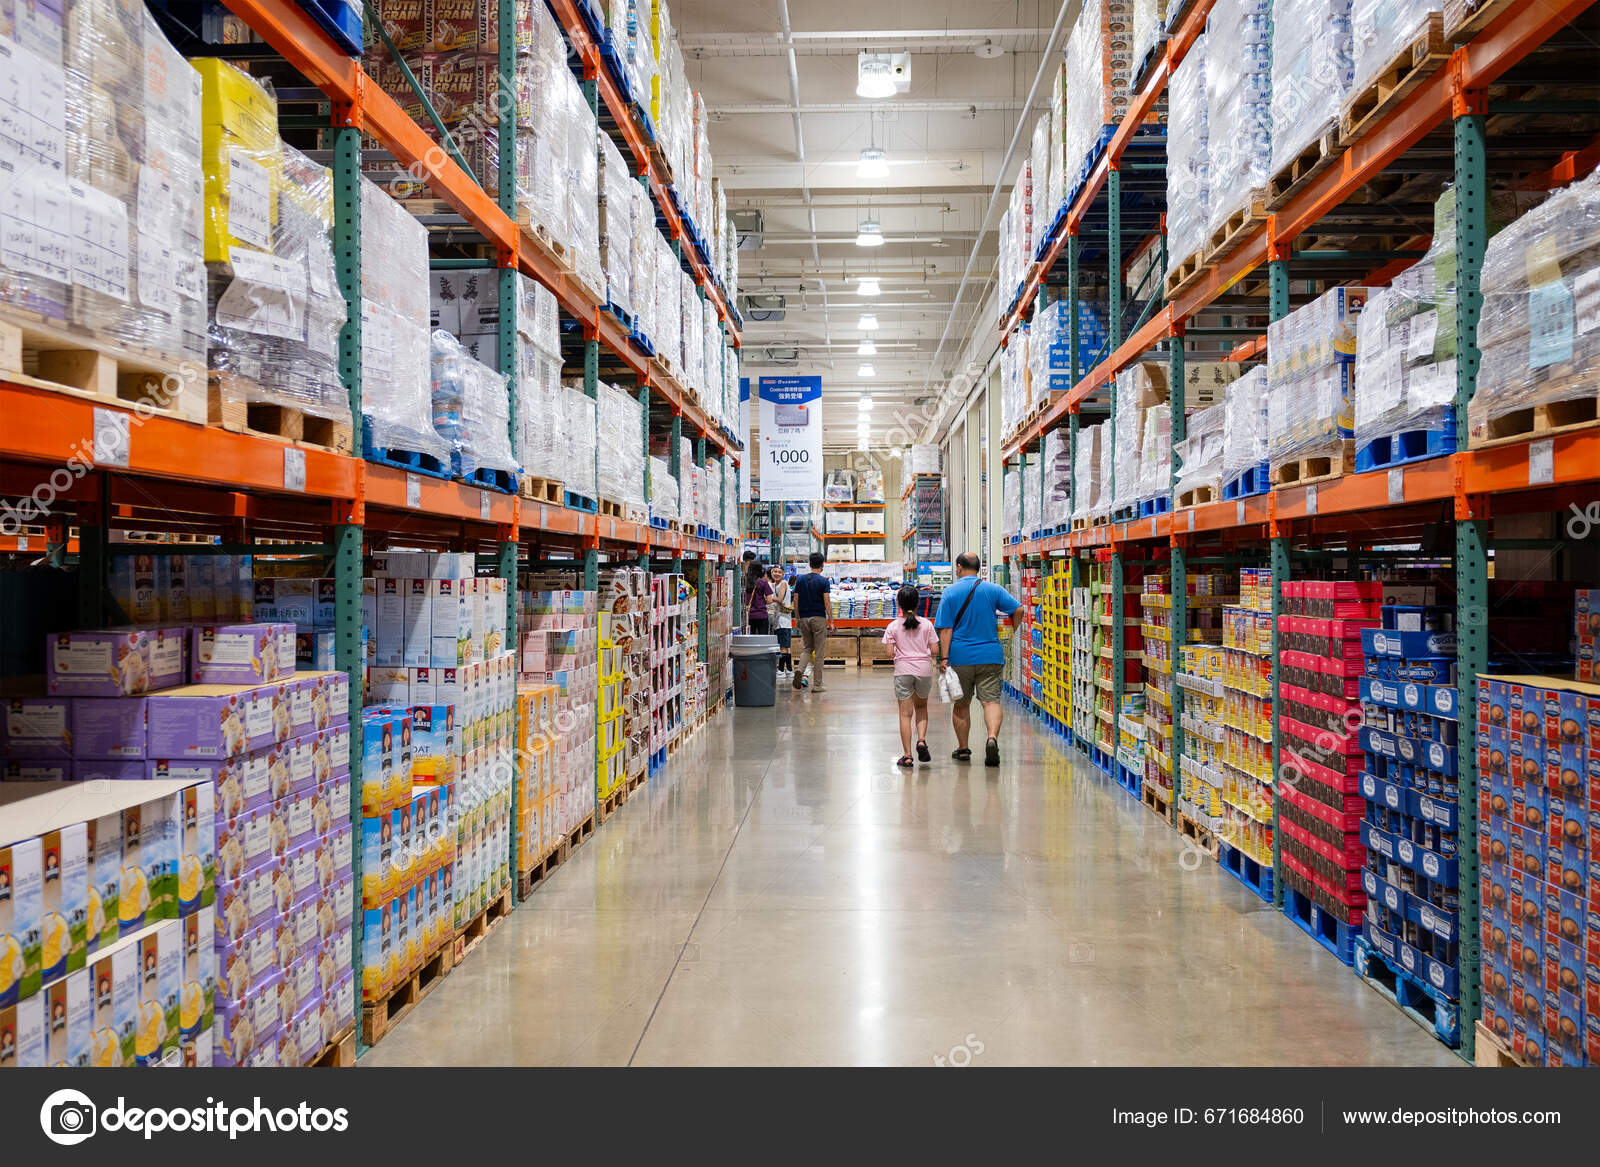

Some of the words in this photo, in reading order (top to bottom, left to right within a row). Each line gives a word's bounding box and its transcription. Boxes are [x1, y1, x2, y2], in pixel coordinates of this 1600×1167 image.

[382, 10, 420, 20] GRAIN
[435, 10, 474, 20] GRAIN
[435, 73, 473, 83] NUTRI
[433, 83, 472, 93] GRAIN
[770, 450, 809, 465] 1,000
